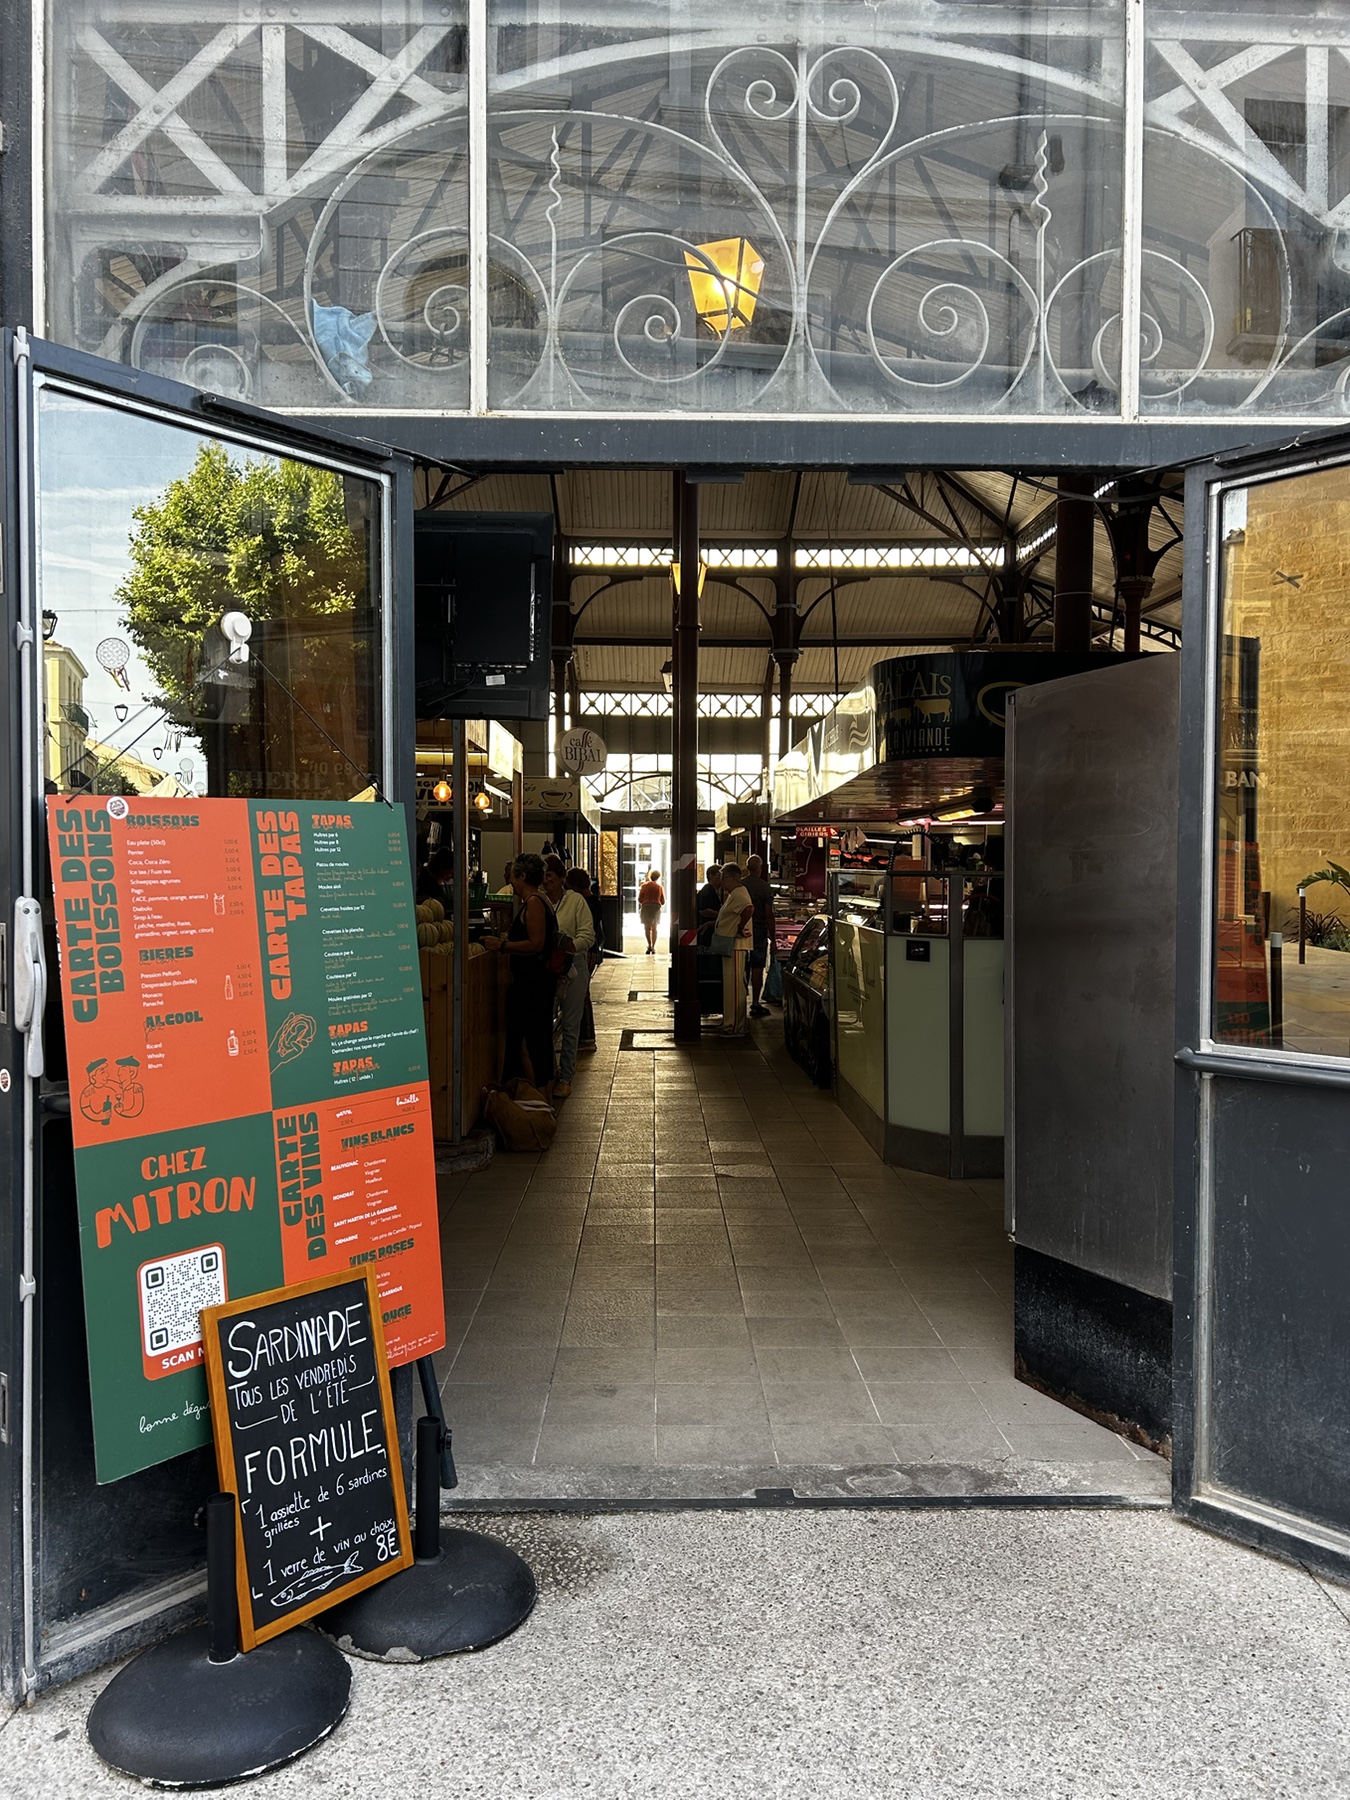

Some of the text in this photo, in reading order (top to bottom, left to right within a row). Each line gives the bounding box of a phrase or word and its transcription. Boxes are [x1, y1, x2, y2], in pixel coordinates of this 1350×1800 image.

[896, 659, 917, 673] AU
[877, 672, 952, 705] PALAIS
[905, 727, 951, 748] VIANDE
[564, 746, 604, 762] BIBAL
[126, 814, 200, 827] BOISSONS
[311, 814, 351, 827] TAPAS
[278, 811, 307, 921] TAPAS
[56, 809, 98, 1022] CARTE DES
[85, 809, 125, 994] BOISSONS
[256, 811, 292, 1000] CARTE DES
[139, 946, 194, 961] BIERES
[146, 1010, 203, 1028] ALCOOL
[328, 1020, 368, 1036] TAPAS
[333, 1056, 373, 1073] TAPAS
[341, 1133, 369, 1149] VINS
[370, 1123, 414, 1142] BLANCS
[141, 1146, 207, 1181] CHEZ
[277, 1115, 303, 1226] CARTE
[298, 1111, 327, 1260] DES VINS
[95, 1176, 256, 1249] MITRON
[350, 1249, 377, 1266] VINS
[378, 1237, 415, 1258] ROSES
[382, 1303, 412, 1323] OUGE
[228, 1302, 367, 1378] SARDINADE
[162, 1350, 195, 1369] SCAN
[228, 1381, 263, 1410] TOUS
[270, 1377, 289, 1400] LES
[139, 1413, 179, 1433] bonne
[280, 1400, 298, 1424] DE
[244, 1409, 382, 1494] FORMULE
[255, 1467, 388, 1530] 1 assiette de 6 sardines
[264, 1516, 300, 1549] grillées
[262, 1559, 277, 1586] 1
[280, 1557, 307, 1578] verre
[313, 1546, 326, 1564] de
[354, 1532, 367, 1544] au
[370, 1518, 393, 1536] choix
